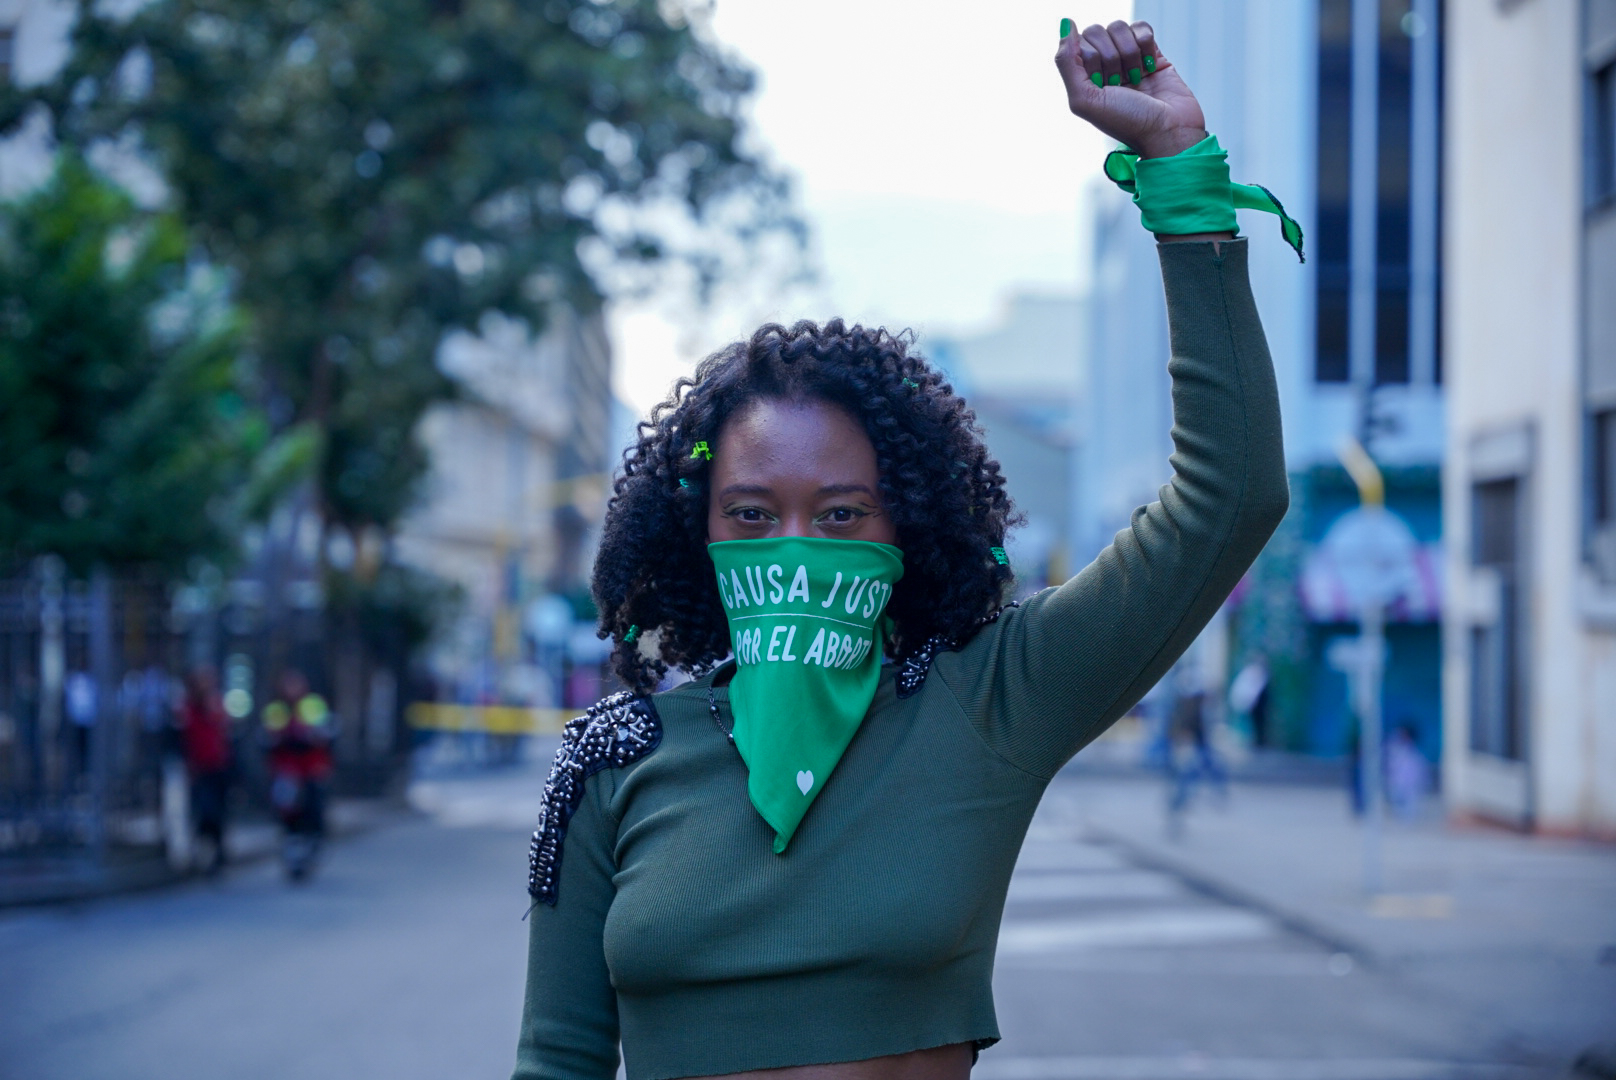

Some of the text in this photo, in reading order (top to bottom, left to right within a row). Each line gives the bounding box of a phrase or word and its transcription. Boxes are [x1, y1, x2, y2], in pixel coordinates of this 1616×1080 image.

[719, 564, 893, 622] CAUSA JUST
[736, 627, 762, 666] POR
[767, 625, 797, 662] EL
